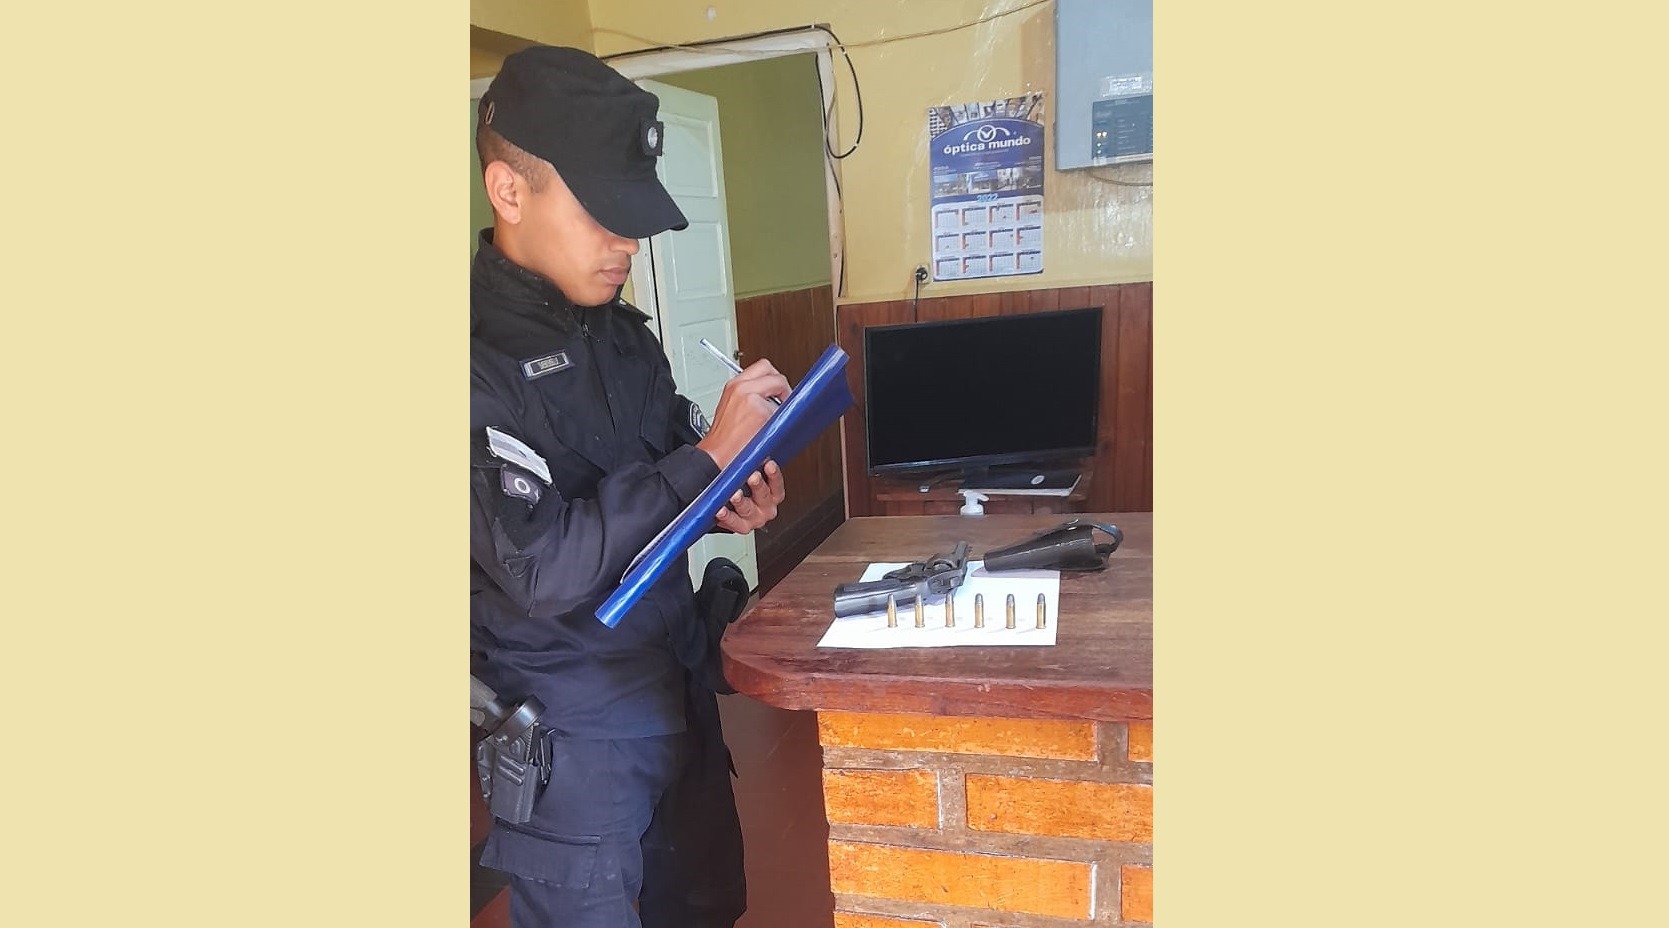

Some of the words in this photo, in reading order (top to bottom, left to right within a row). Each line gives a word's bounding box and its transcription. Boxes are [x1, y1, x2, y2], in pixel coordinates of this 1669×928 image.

[943, 141, 985, 155] óptica
[988, 136, 1031, 149] mundo
[976, 193, 998, 203] 2022
